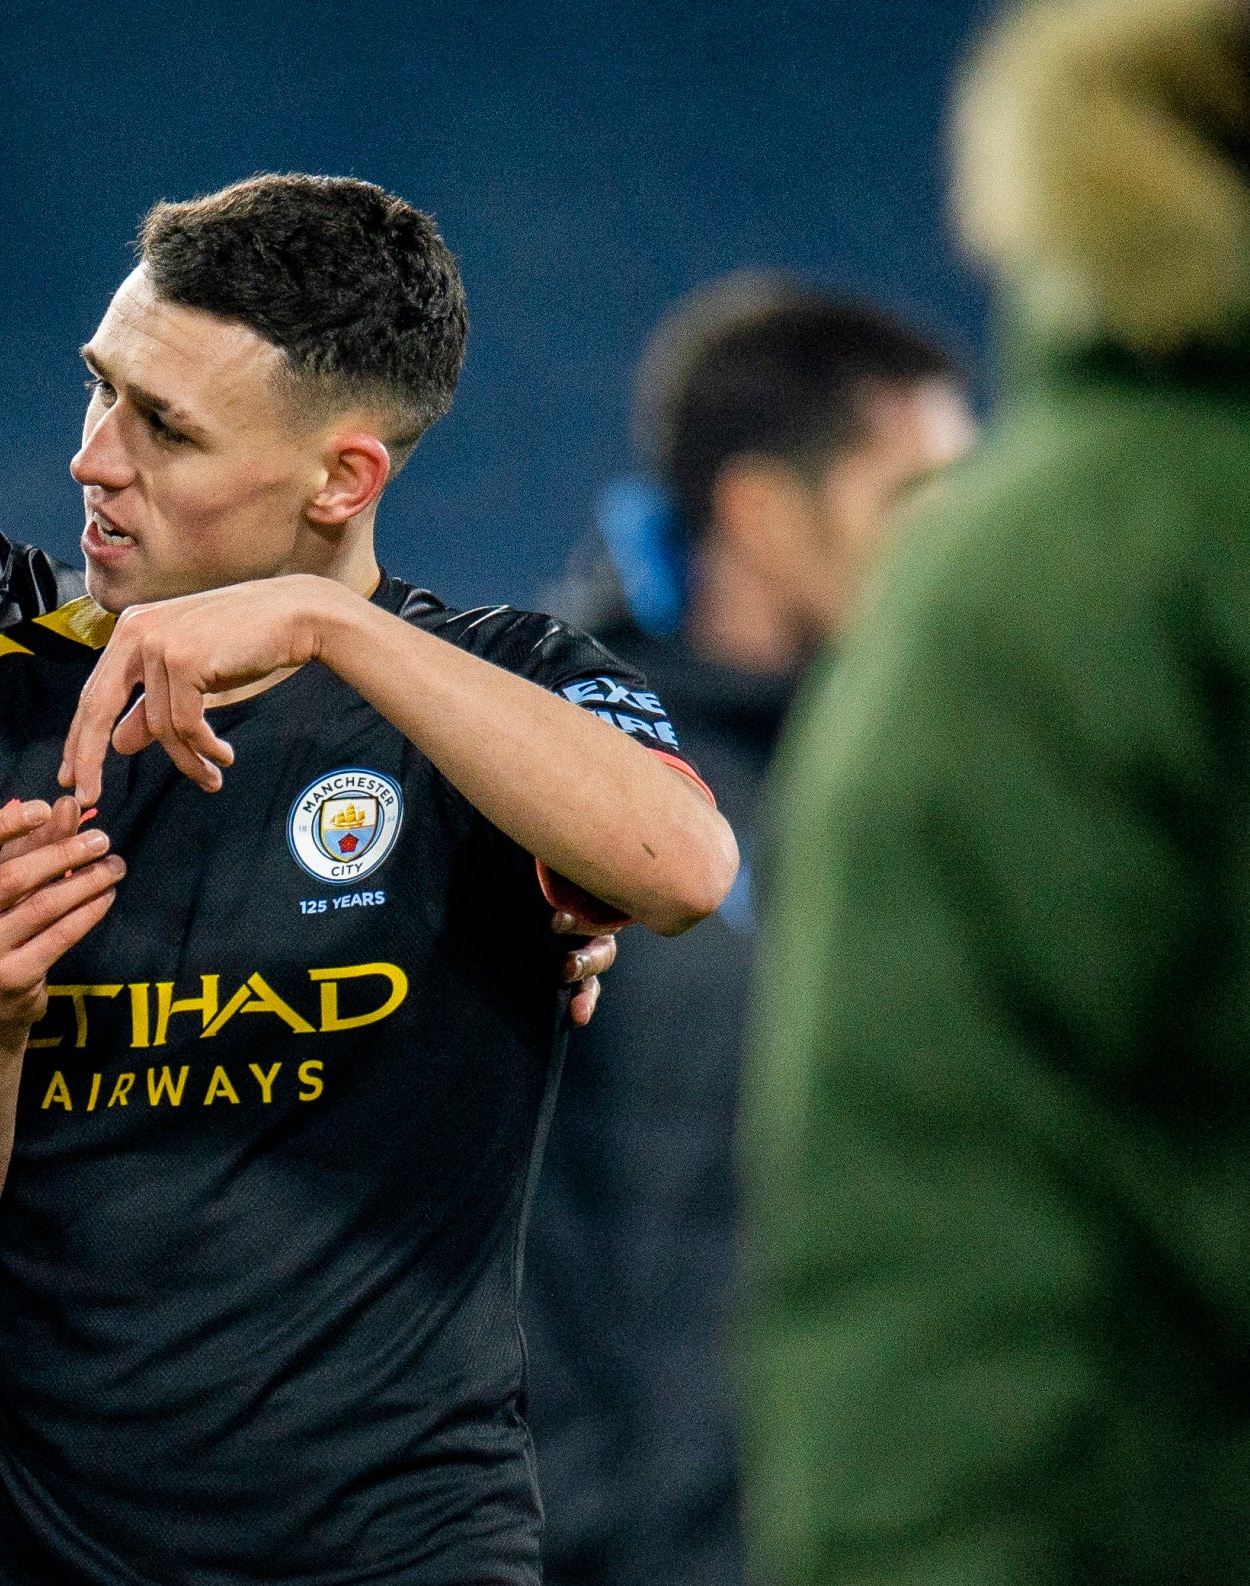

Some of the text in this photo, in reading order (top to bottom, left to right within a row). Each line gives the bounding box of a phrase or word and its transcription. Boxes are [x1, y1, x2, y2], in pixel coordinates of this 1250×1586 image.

[554, 677, 667, 716] EXE
[590, 709, 679, 746] IRE
[302, 776, 394, 813] MANCHESTER
[331, 862, 363, 877] CITY
[300, 891, 386, 914] 125 YEARS
[41, 1060, 324, 1112] AIRWAYS
